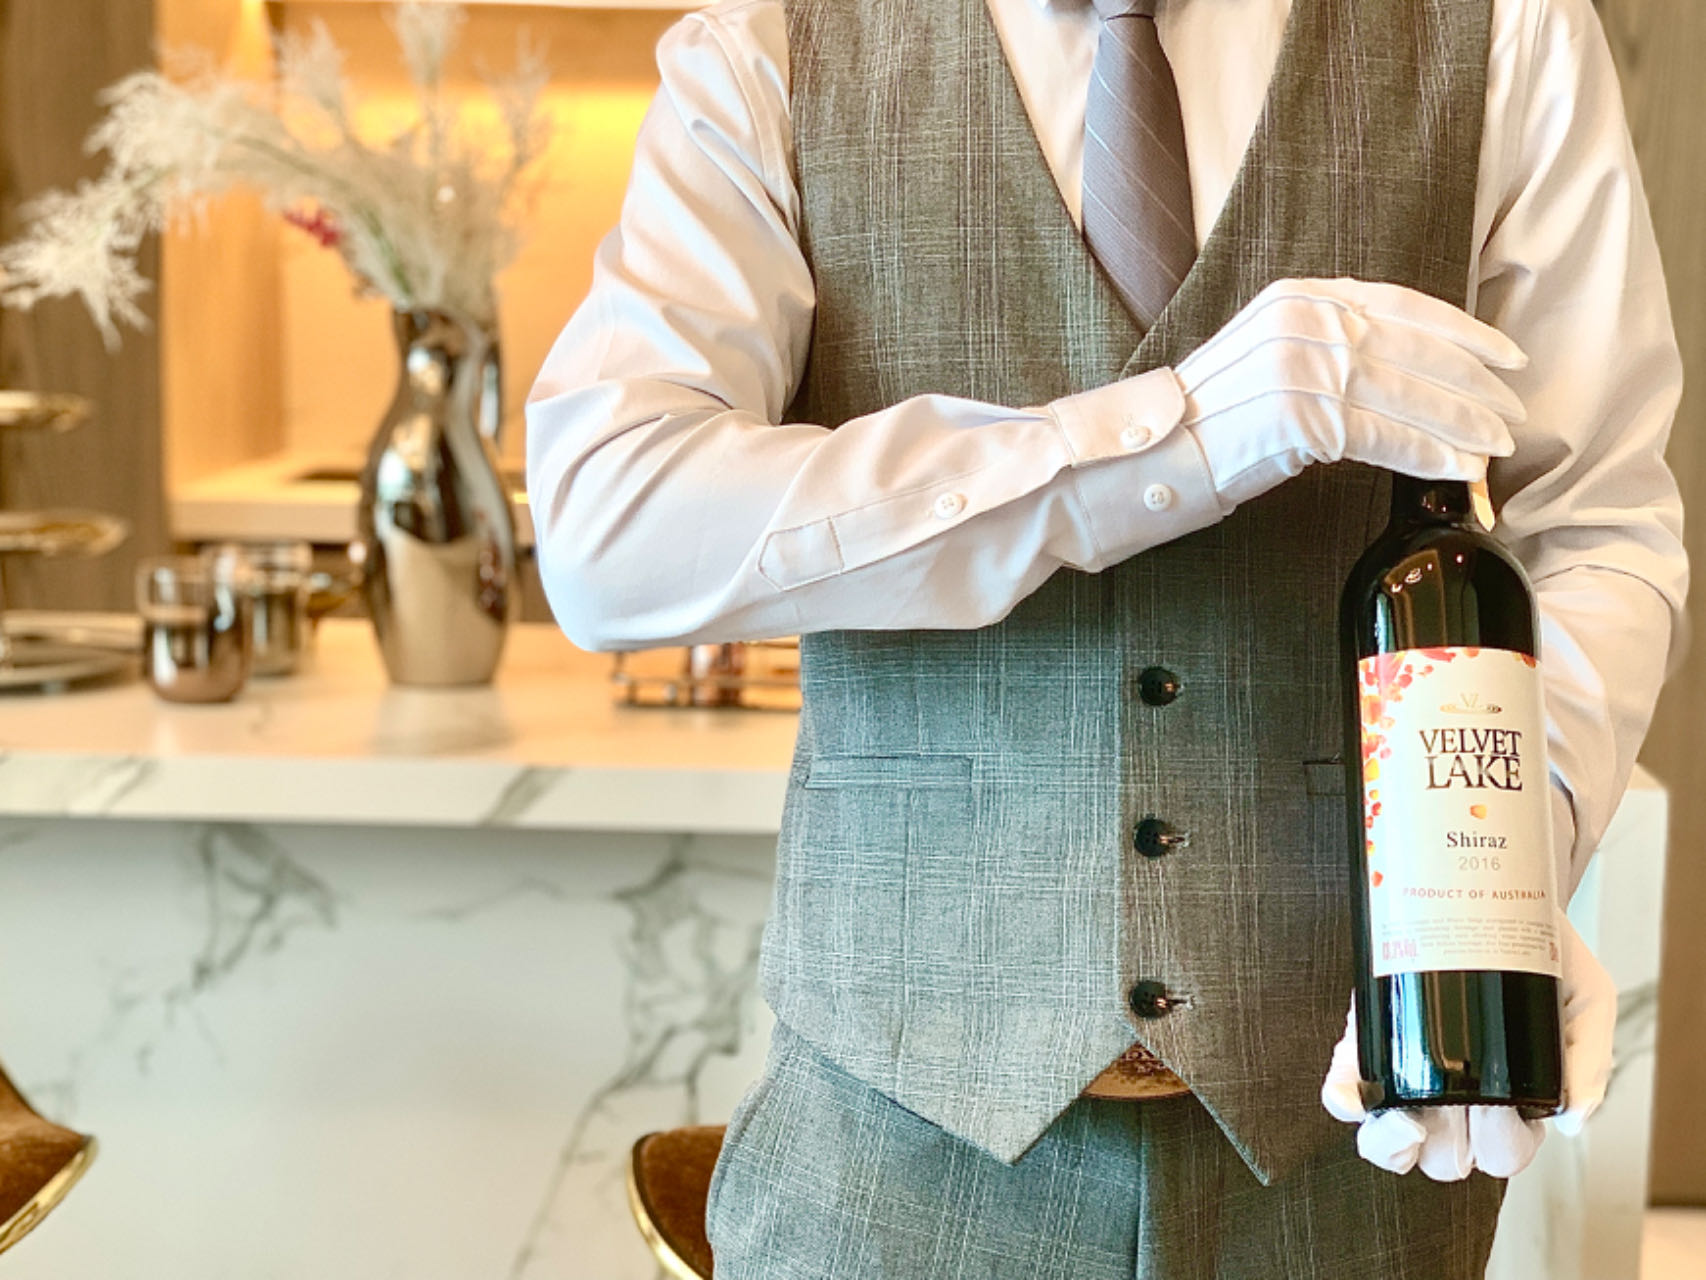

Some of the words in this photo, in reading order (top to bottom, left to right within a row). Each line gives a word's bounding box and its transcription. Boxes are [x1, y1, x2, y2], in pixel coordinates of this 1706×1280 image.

[1418, 727, 1523, 757] VELVET
[1424, 755, 1523, 792] LAKE
[1446, 831, 1508, 850] Shiraz
[1458, 856, 1502, 871] 2016
[1402, 887, 1463, 899] PRODUCT
[1468, 889, 1485, 900] OF
[1491, 890, 1547, 901] AUSTRALIA
